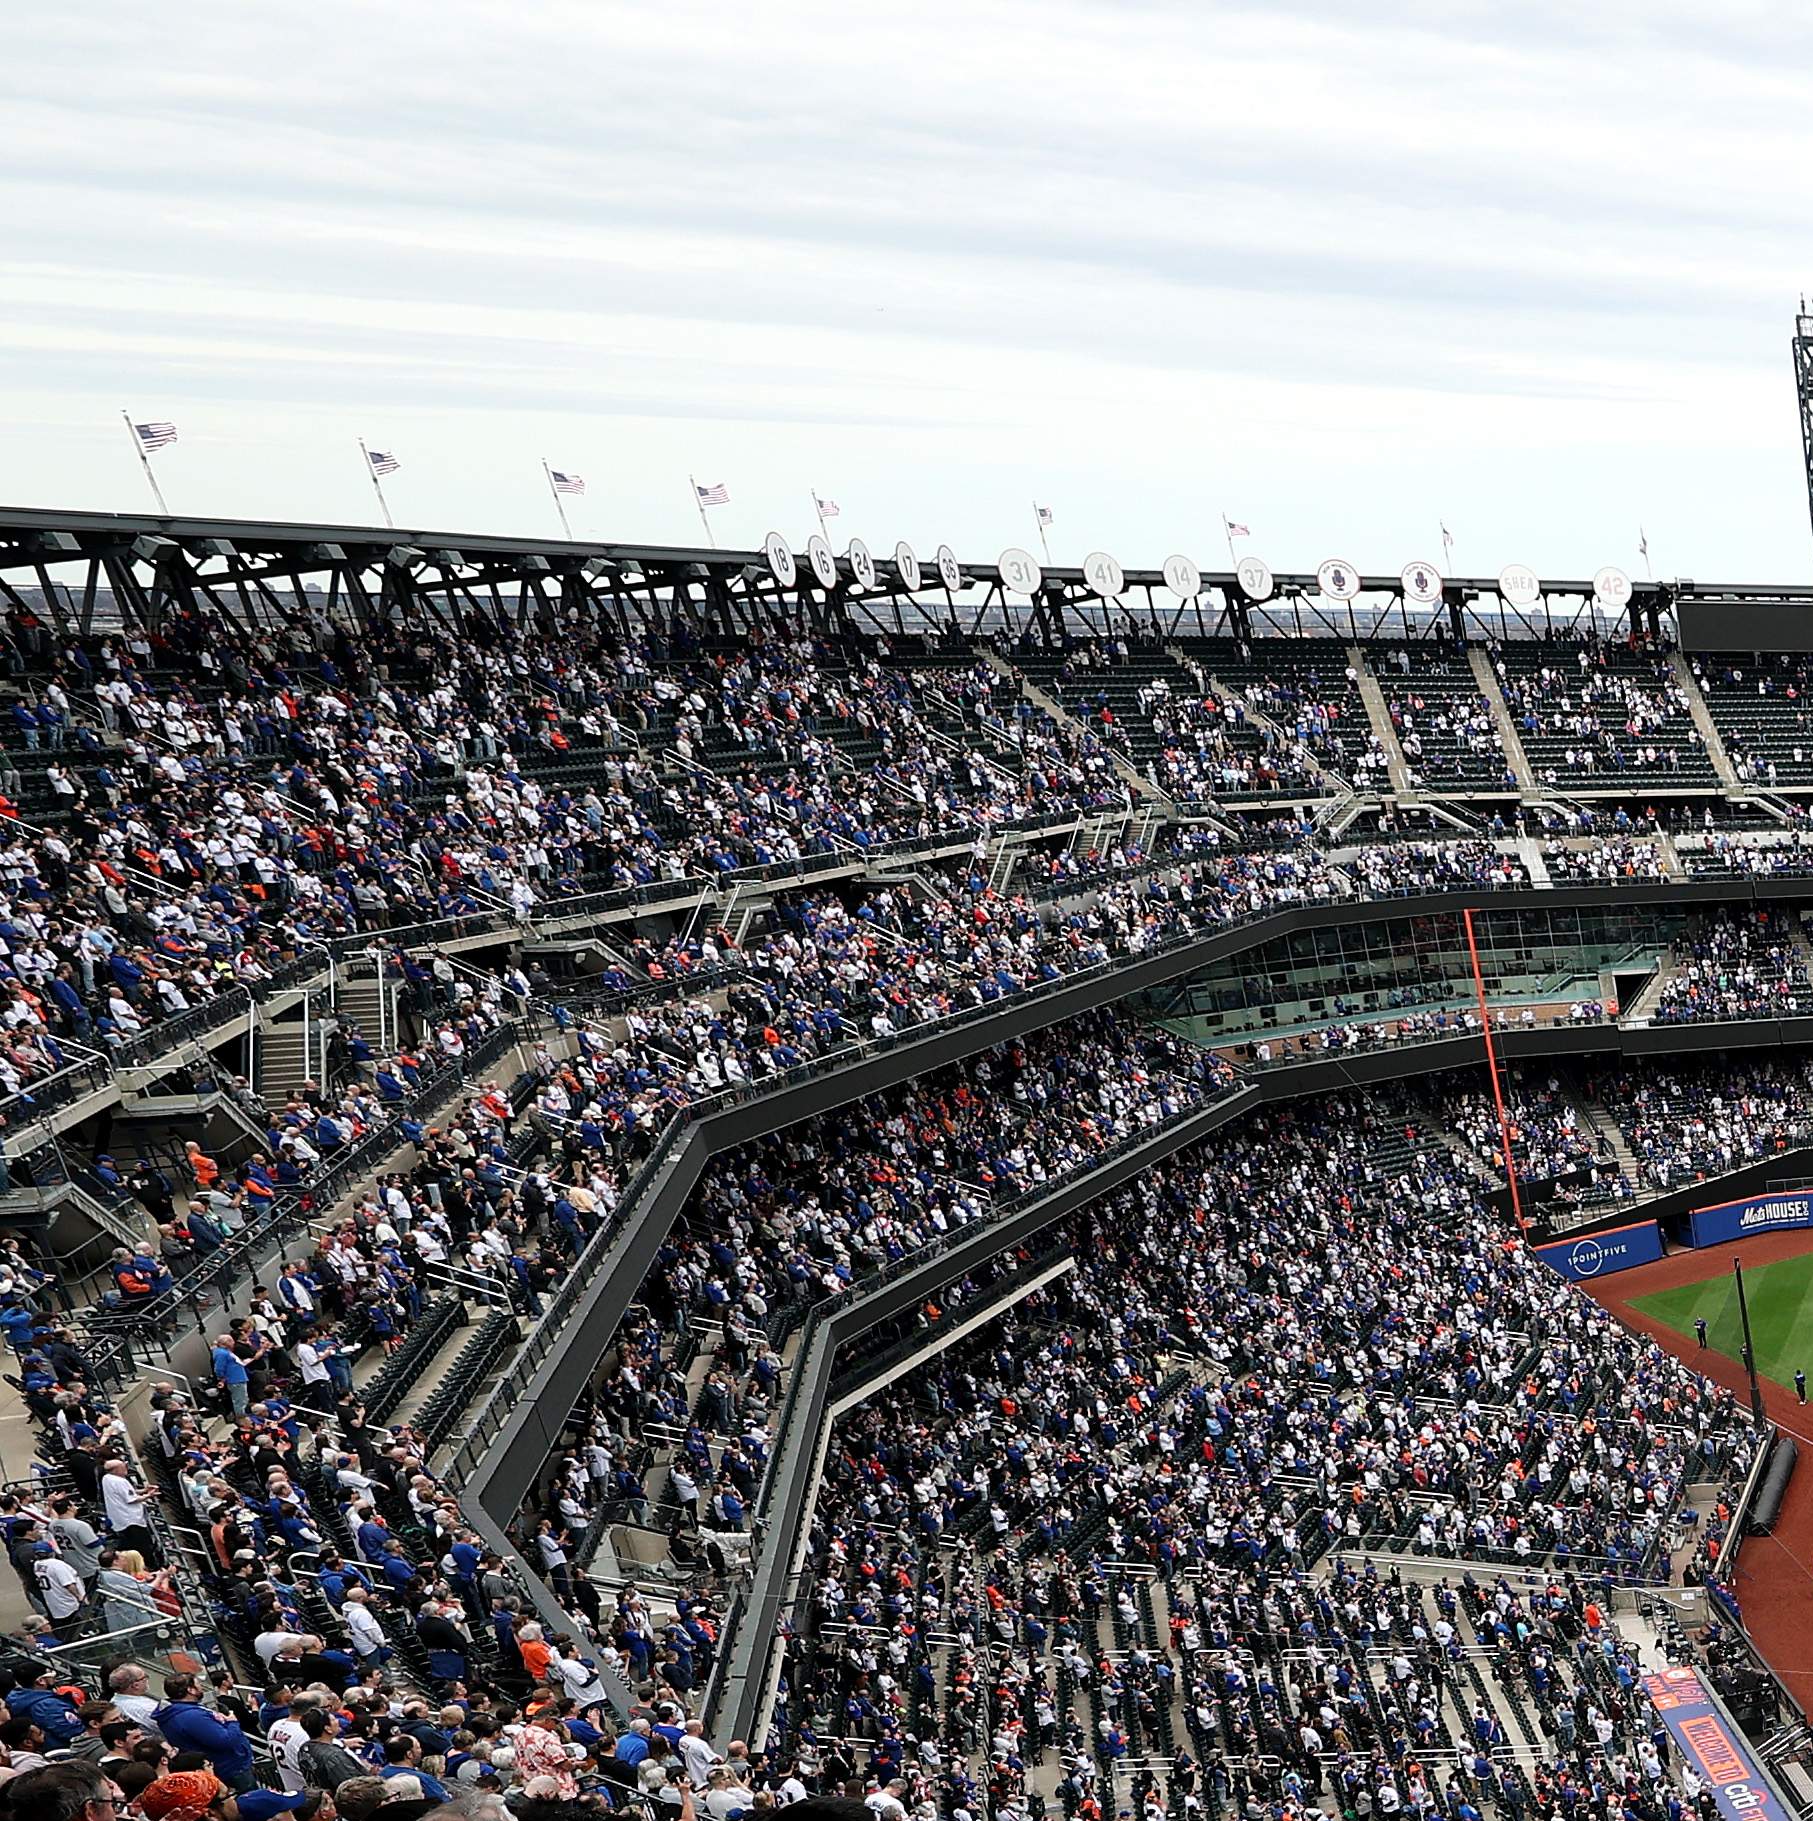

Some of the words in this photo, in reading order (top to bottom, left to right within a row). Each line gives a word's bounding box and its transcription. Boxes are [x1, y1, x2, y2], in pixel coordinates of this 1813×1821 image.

[773, 547, 789, 572] 18
[815, 550, 831, 574] 16
[854, 552, 871, 576] 24
[902, 556, 914, 577] 17
[1009, 560, 1032, 582] 31
[1095, 563, 1115, 585] 41
[1172, 566, 1190, 586] 14
[1244, 569, 1265, 588] 37
[1504, 575, 1535, 591] SHEA
[1601, 577, 1625, 595] 42
[1687, 1720, 1740, 1769] WELCOME
[1713, 1765, 1744, 1782] TO
